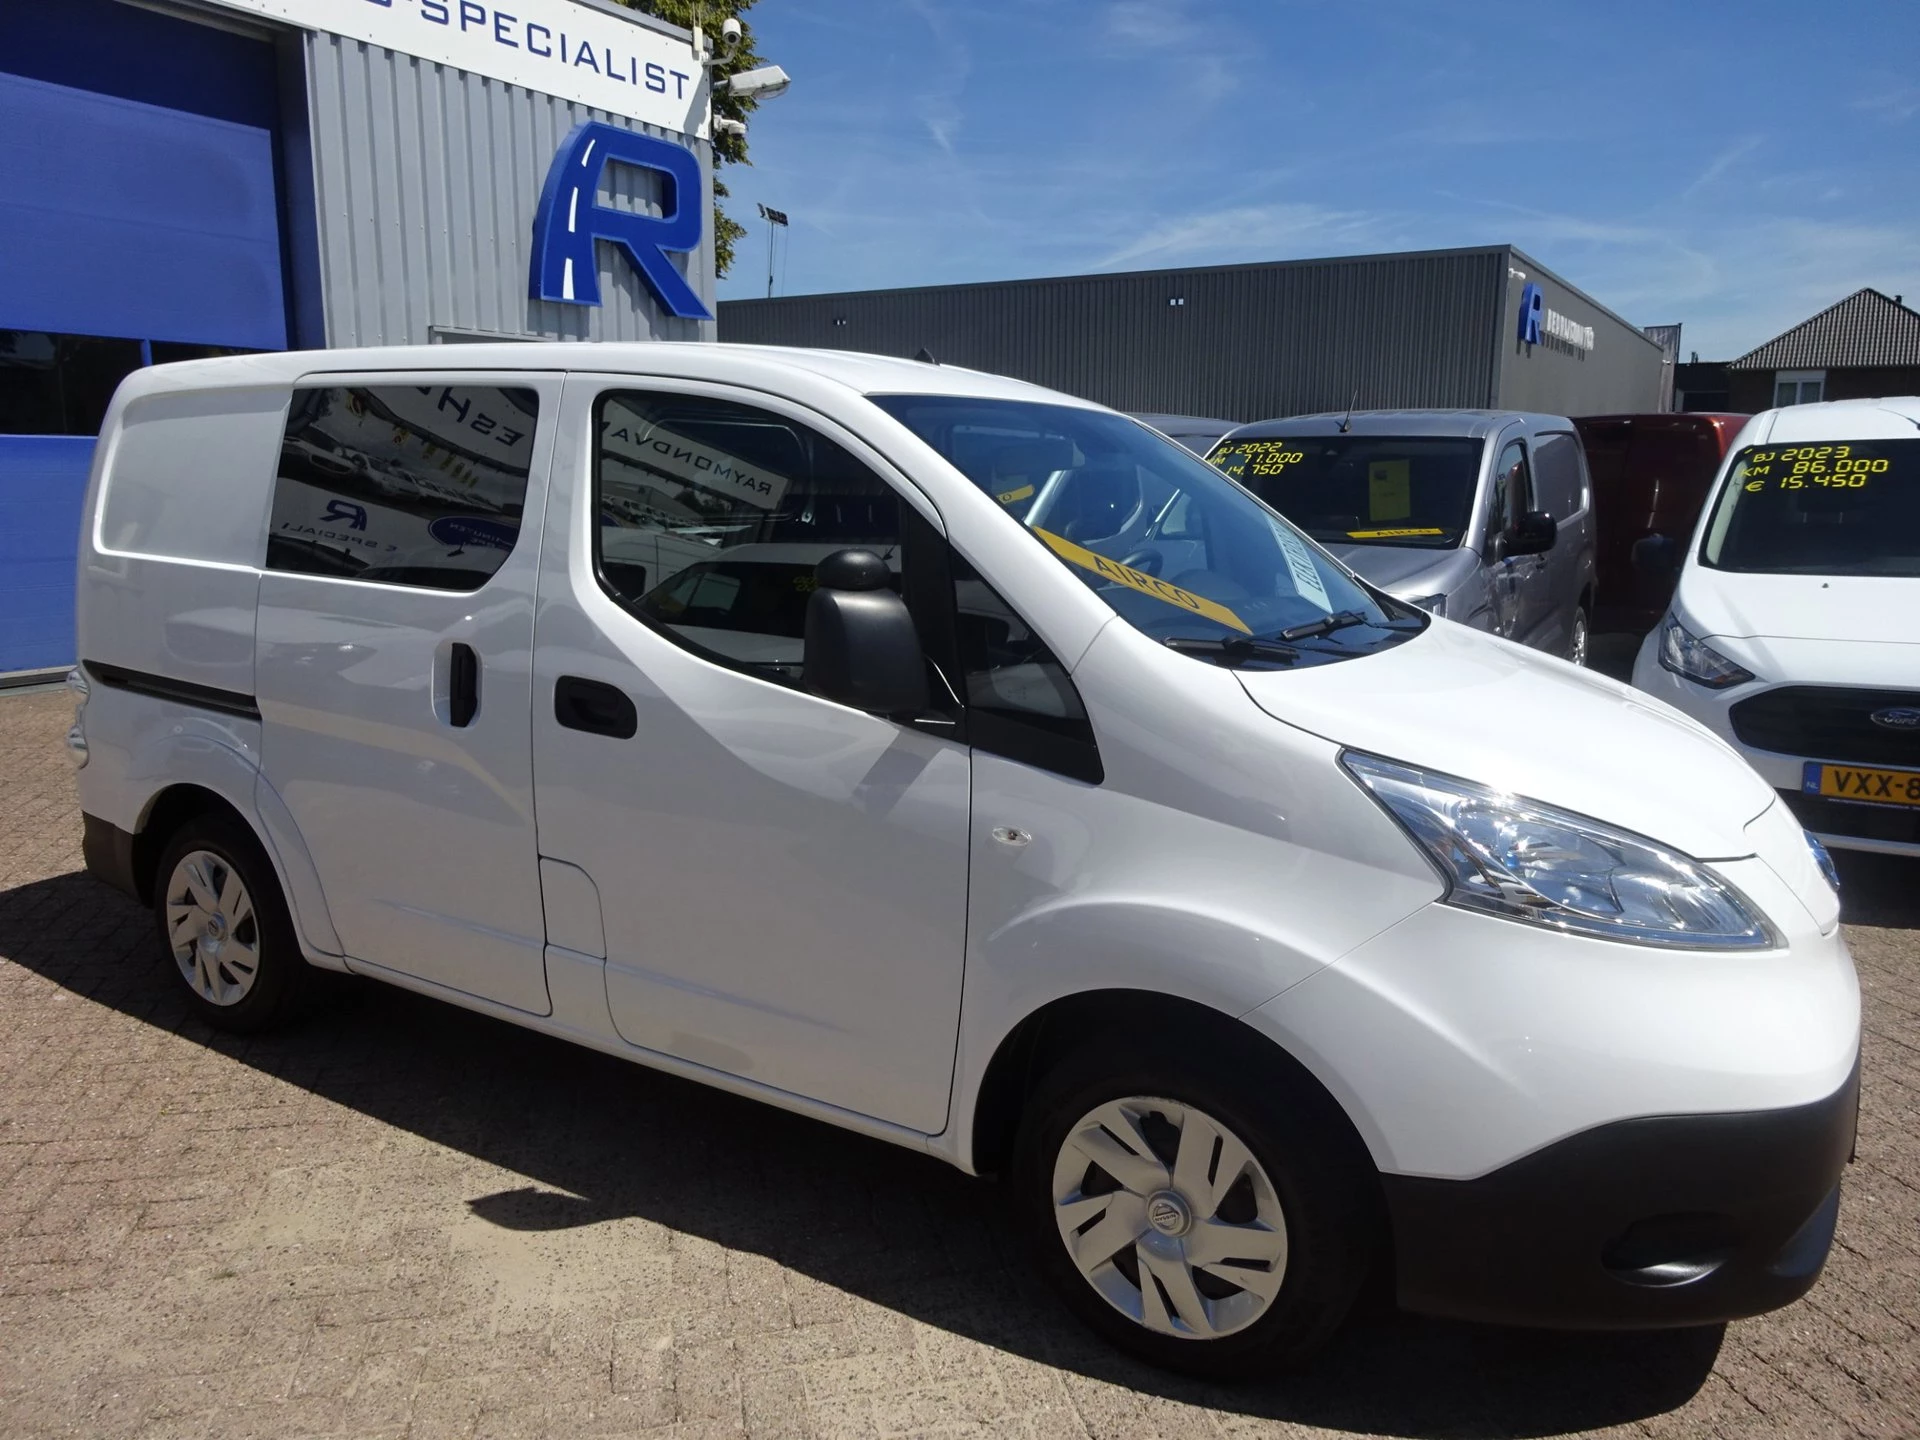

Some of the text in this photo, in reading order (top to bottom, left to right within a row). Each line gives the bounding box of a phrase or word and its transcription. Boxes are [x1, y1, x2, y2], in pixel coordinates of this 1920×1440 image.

[421, 0, 690, 100] SPECIALIST
[528, 120, 715, 321] R
[1235, 441, 1283, 454] 2022
[1753, 446, 1852, 463] BJ 2023
[1740, 459, 1889, 477] KM 86.000
[1780, 473, 1867, 489] 15.450
[1093, 555, 1200, 609] AIRCO
[1806, 780, 1819, 790] NL
